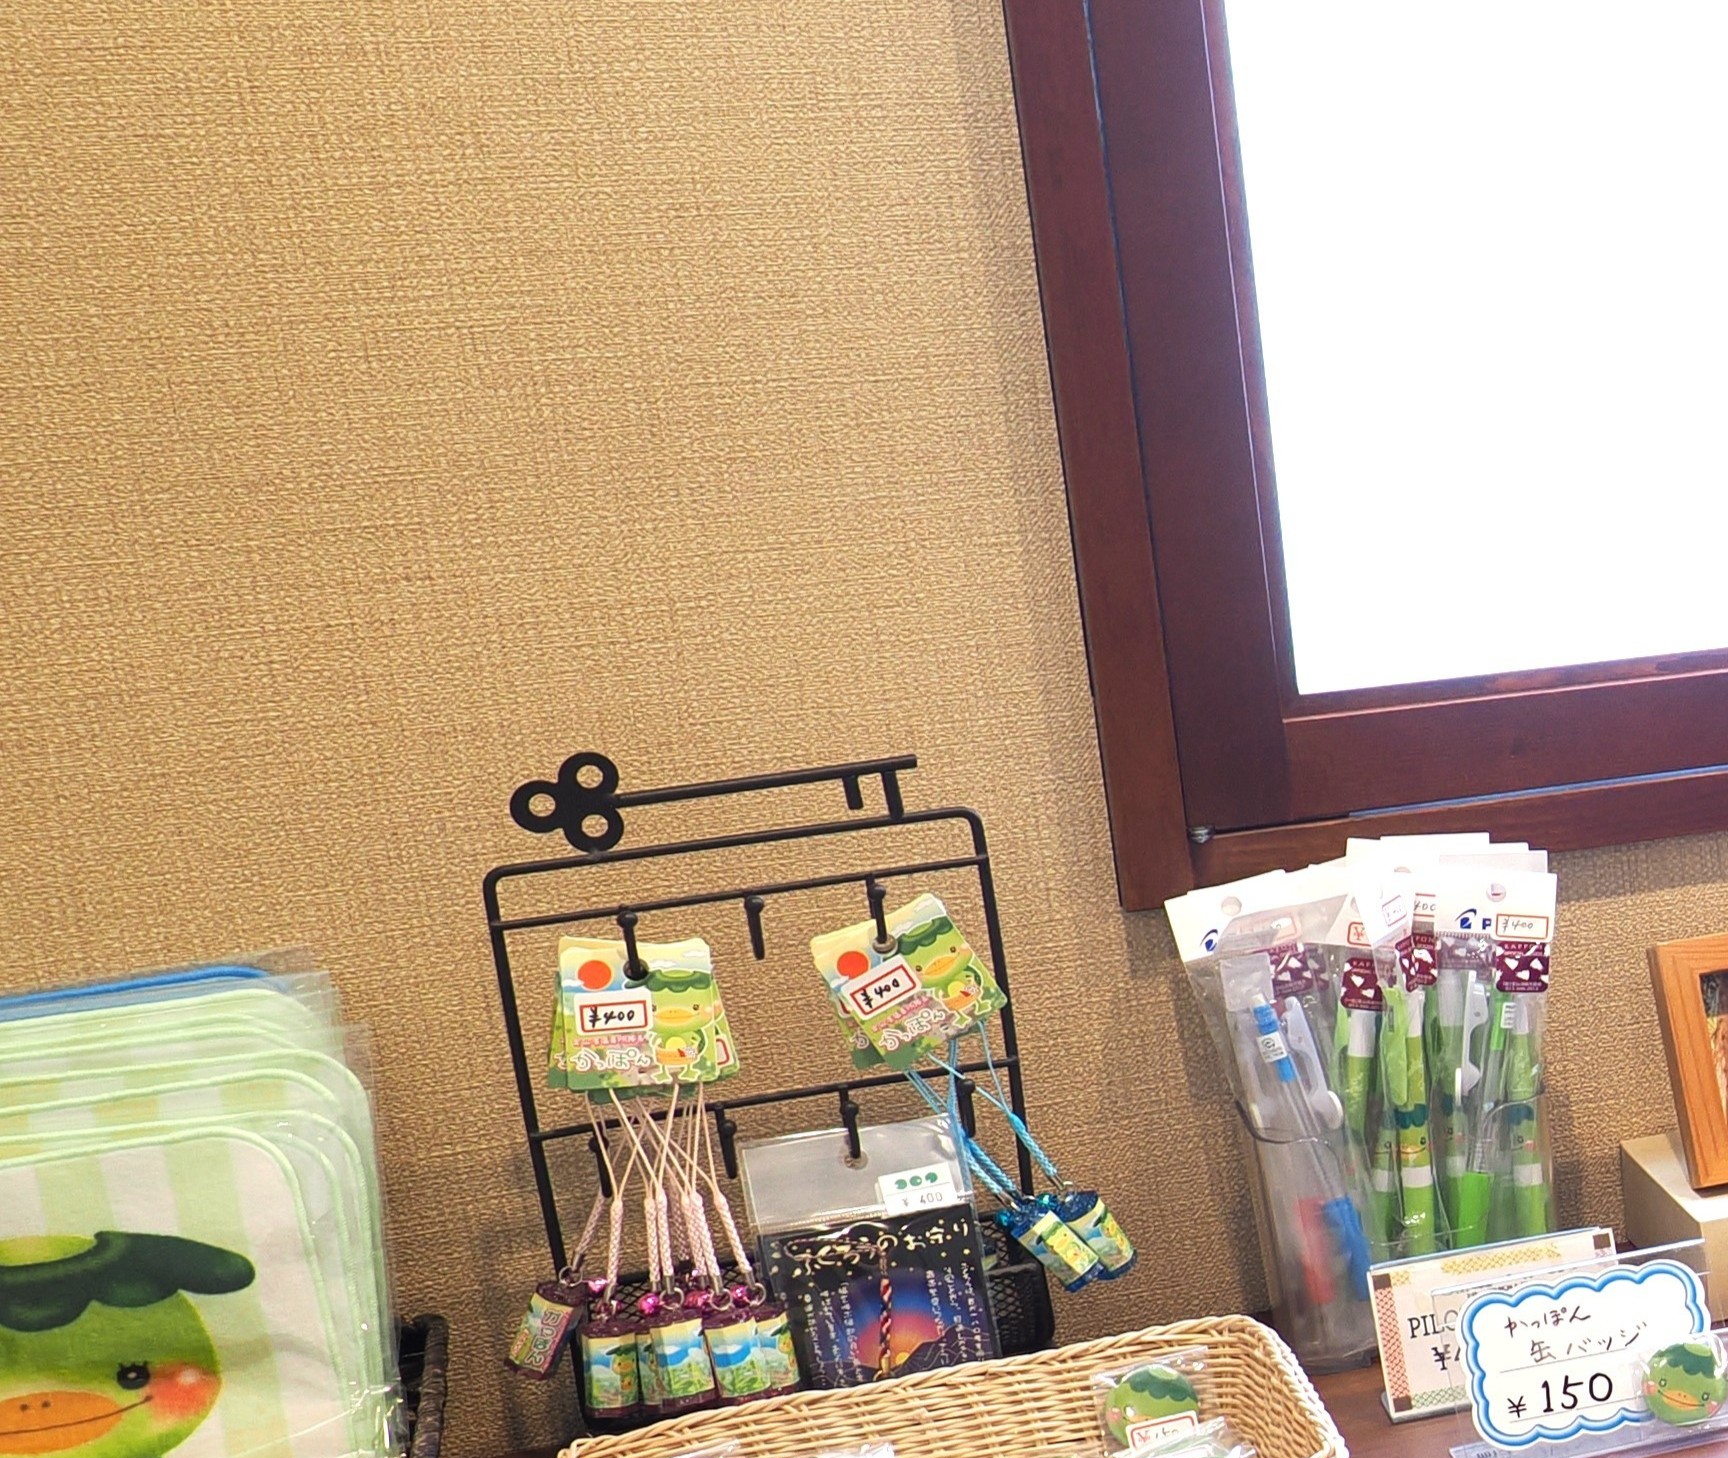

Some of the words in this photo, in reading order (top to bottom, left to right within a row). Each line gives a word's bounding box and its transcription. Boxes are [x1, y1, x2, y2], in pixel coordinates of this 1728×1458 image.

[1502, 917, 1534, 933] ¥400
[861, 978, 900, 1009] ¥400
[588, 1006, 635, 1029] ¥400
[880, 1008, 946, 1050] かっぽん
[571, 1048, 651, 1071] かっぽん
[920, 1191, 943, 1205] 400
[1505, 1305, 1592, 1337] かっぽん
[525, 1308, 564, 1366] かっぽん
[1530, 1322, 1649, 1362] 缶バッジ
[1507, 1371, 1614, 1419] ¥150
